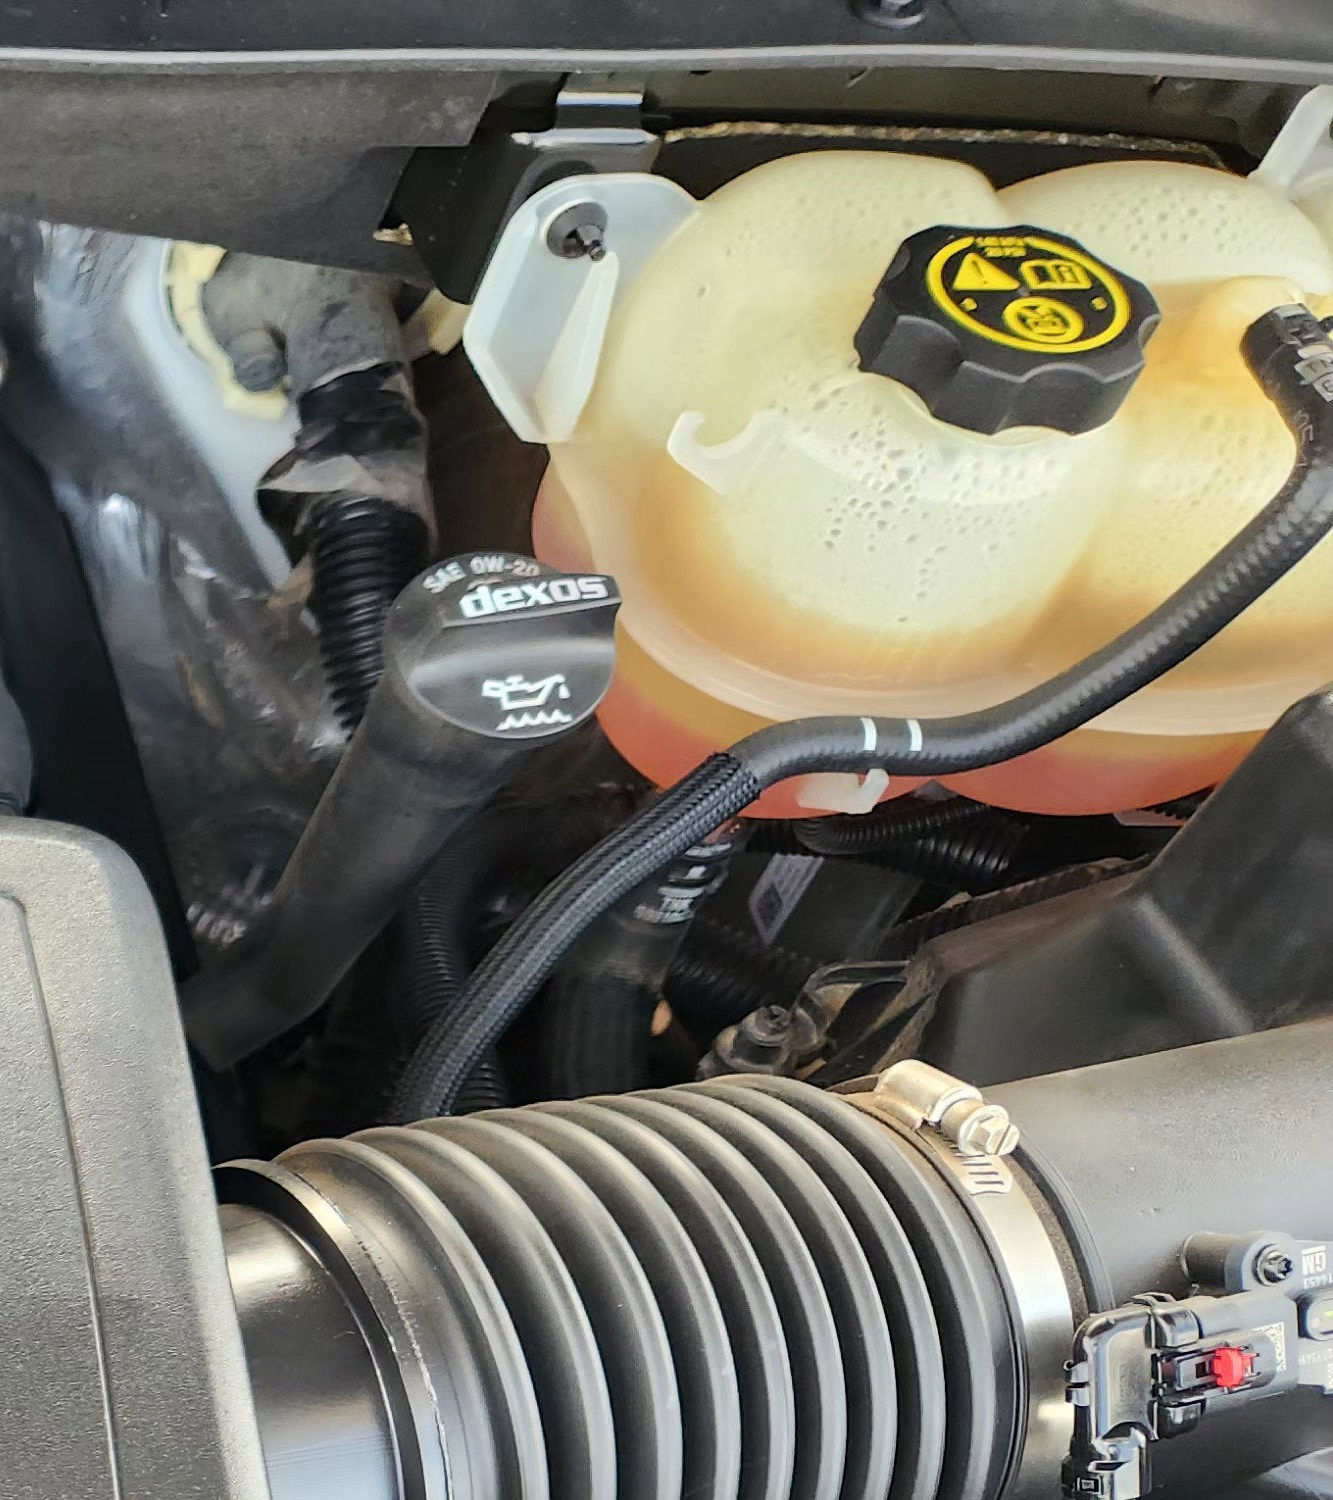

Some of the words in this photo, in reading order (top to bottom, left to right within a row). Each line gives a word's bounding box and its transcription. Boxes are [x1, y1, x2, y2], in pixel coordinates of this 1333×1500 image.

[423, 562, 466, 594] SAE
[470, 556, 539, 577] 0W-20
[459, 577, 609, 619] dexos
[1302, 1252, 1326, 1275] GM
